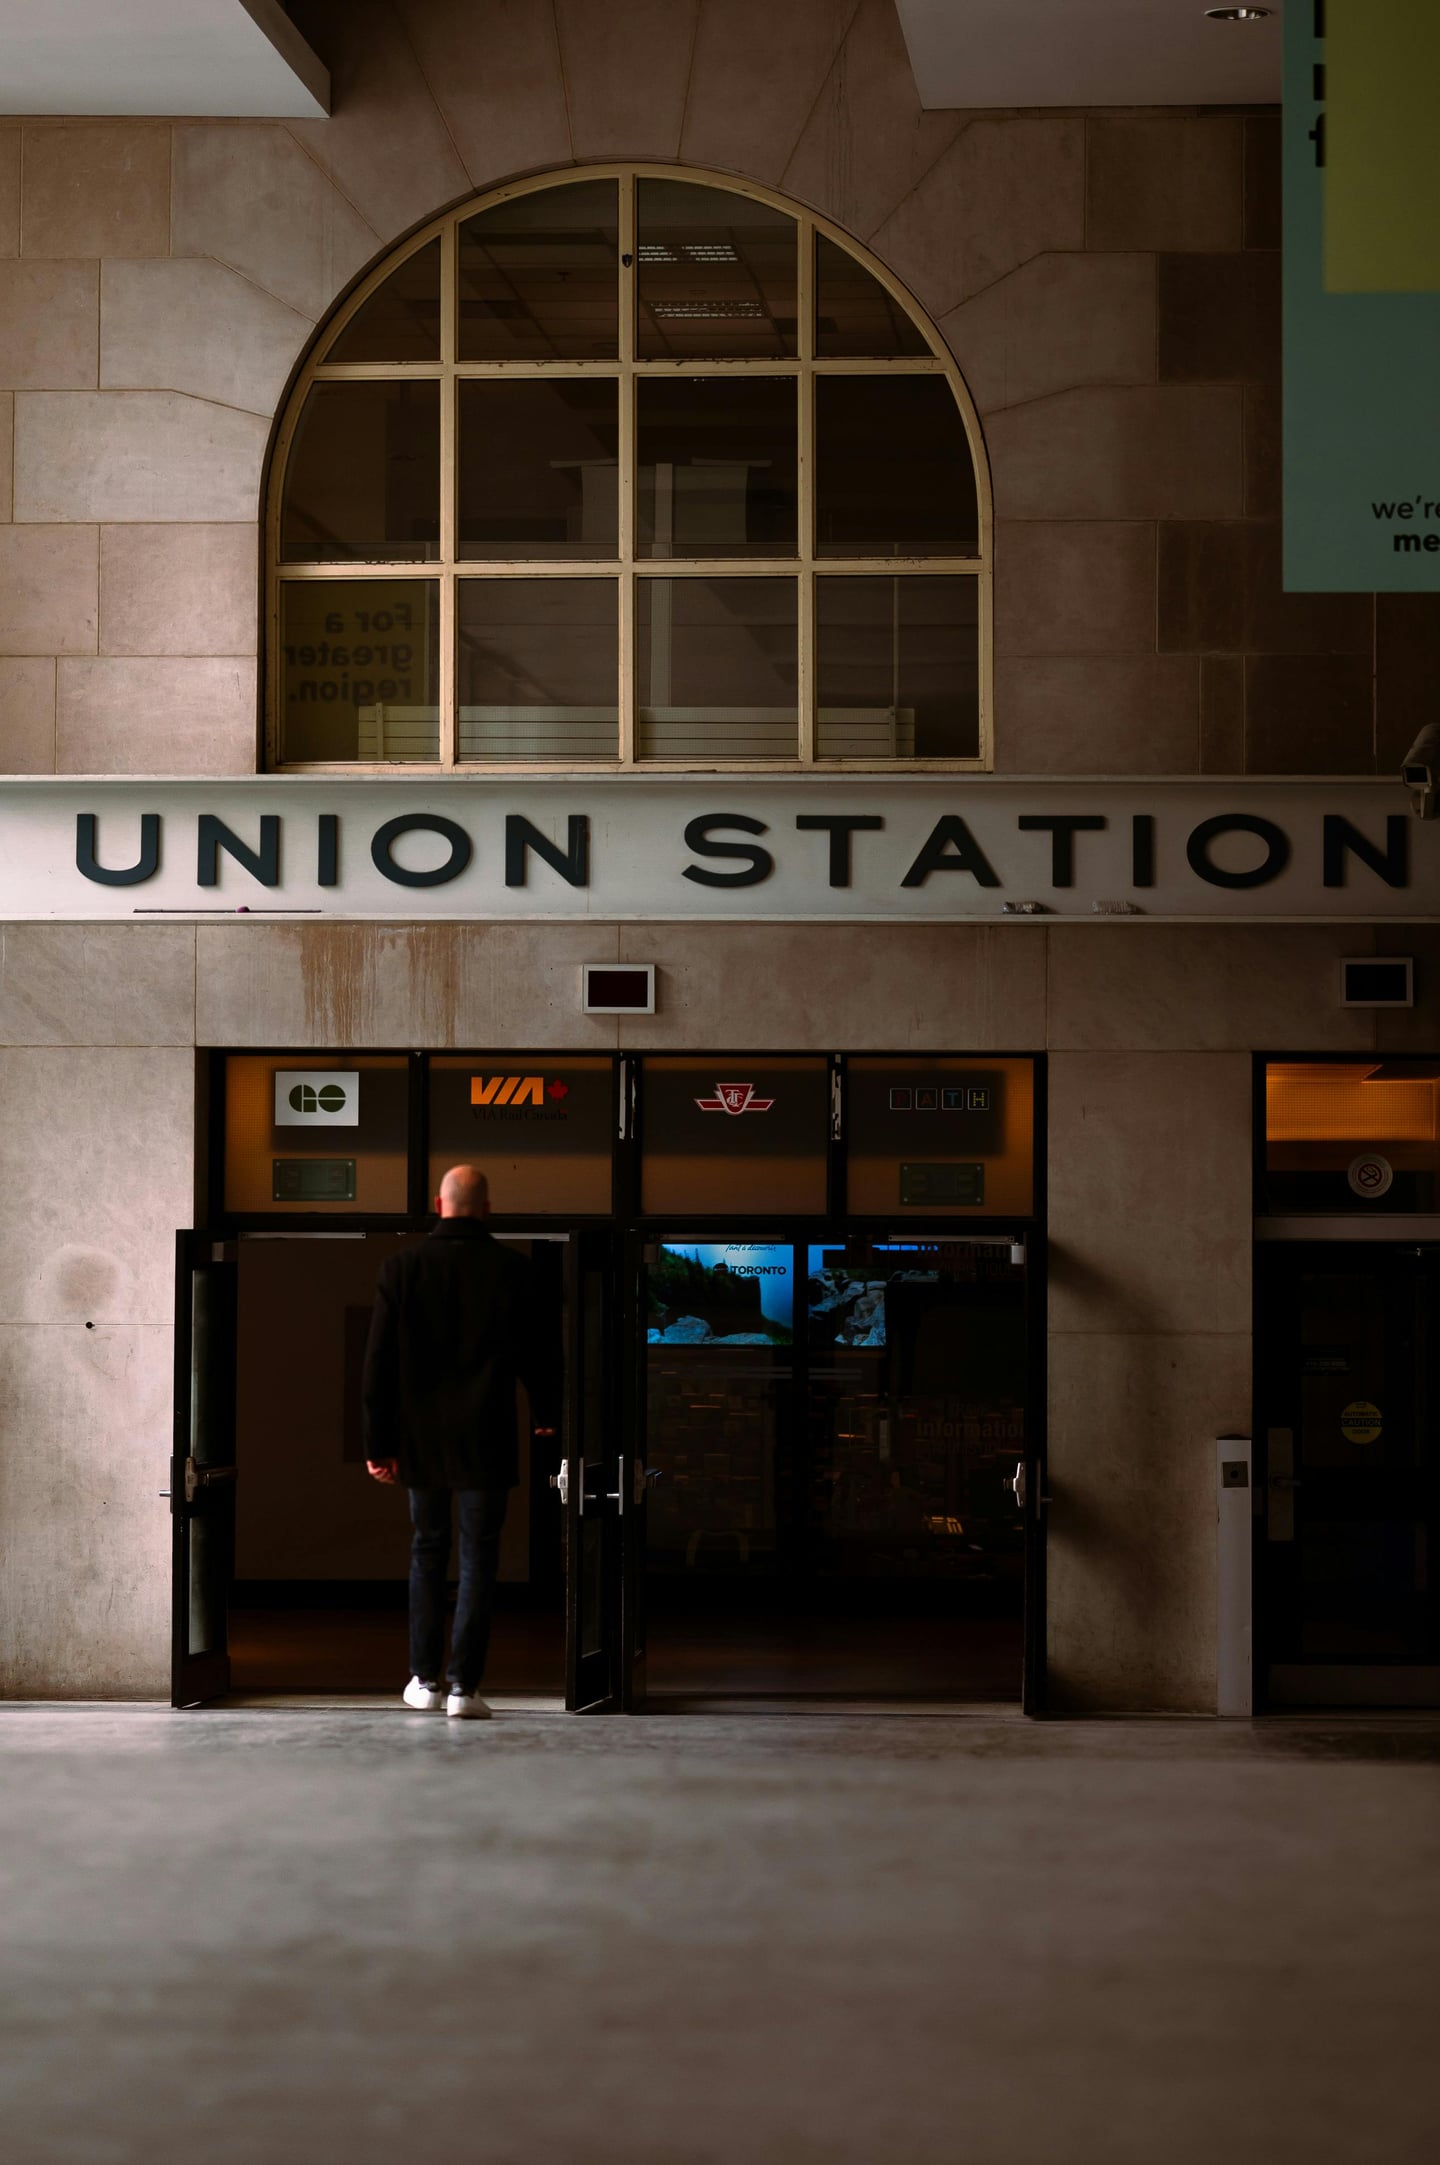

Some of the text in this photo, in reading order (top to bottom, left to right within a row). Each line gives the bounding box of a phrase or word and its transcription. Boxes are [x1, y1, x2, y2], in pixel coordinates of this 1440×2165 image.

[1393, 533, 1440, 552] me
[76, 813, 1407, 888] UNION STATION
[470, 1076, 545, 1105] VIA
[731, 1265, 787, 1275] TORONTO
